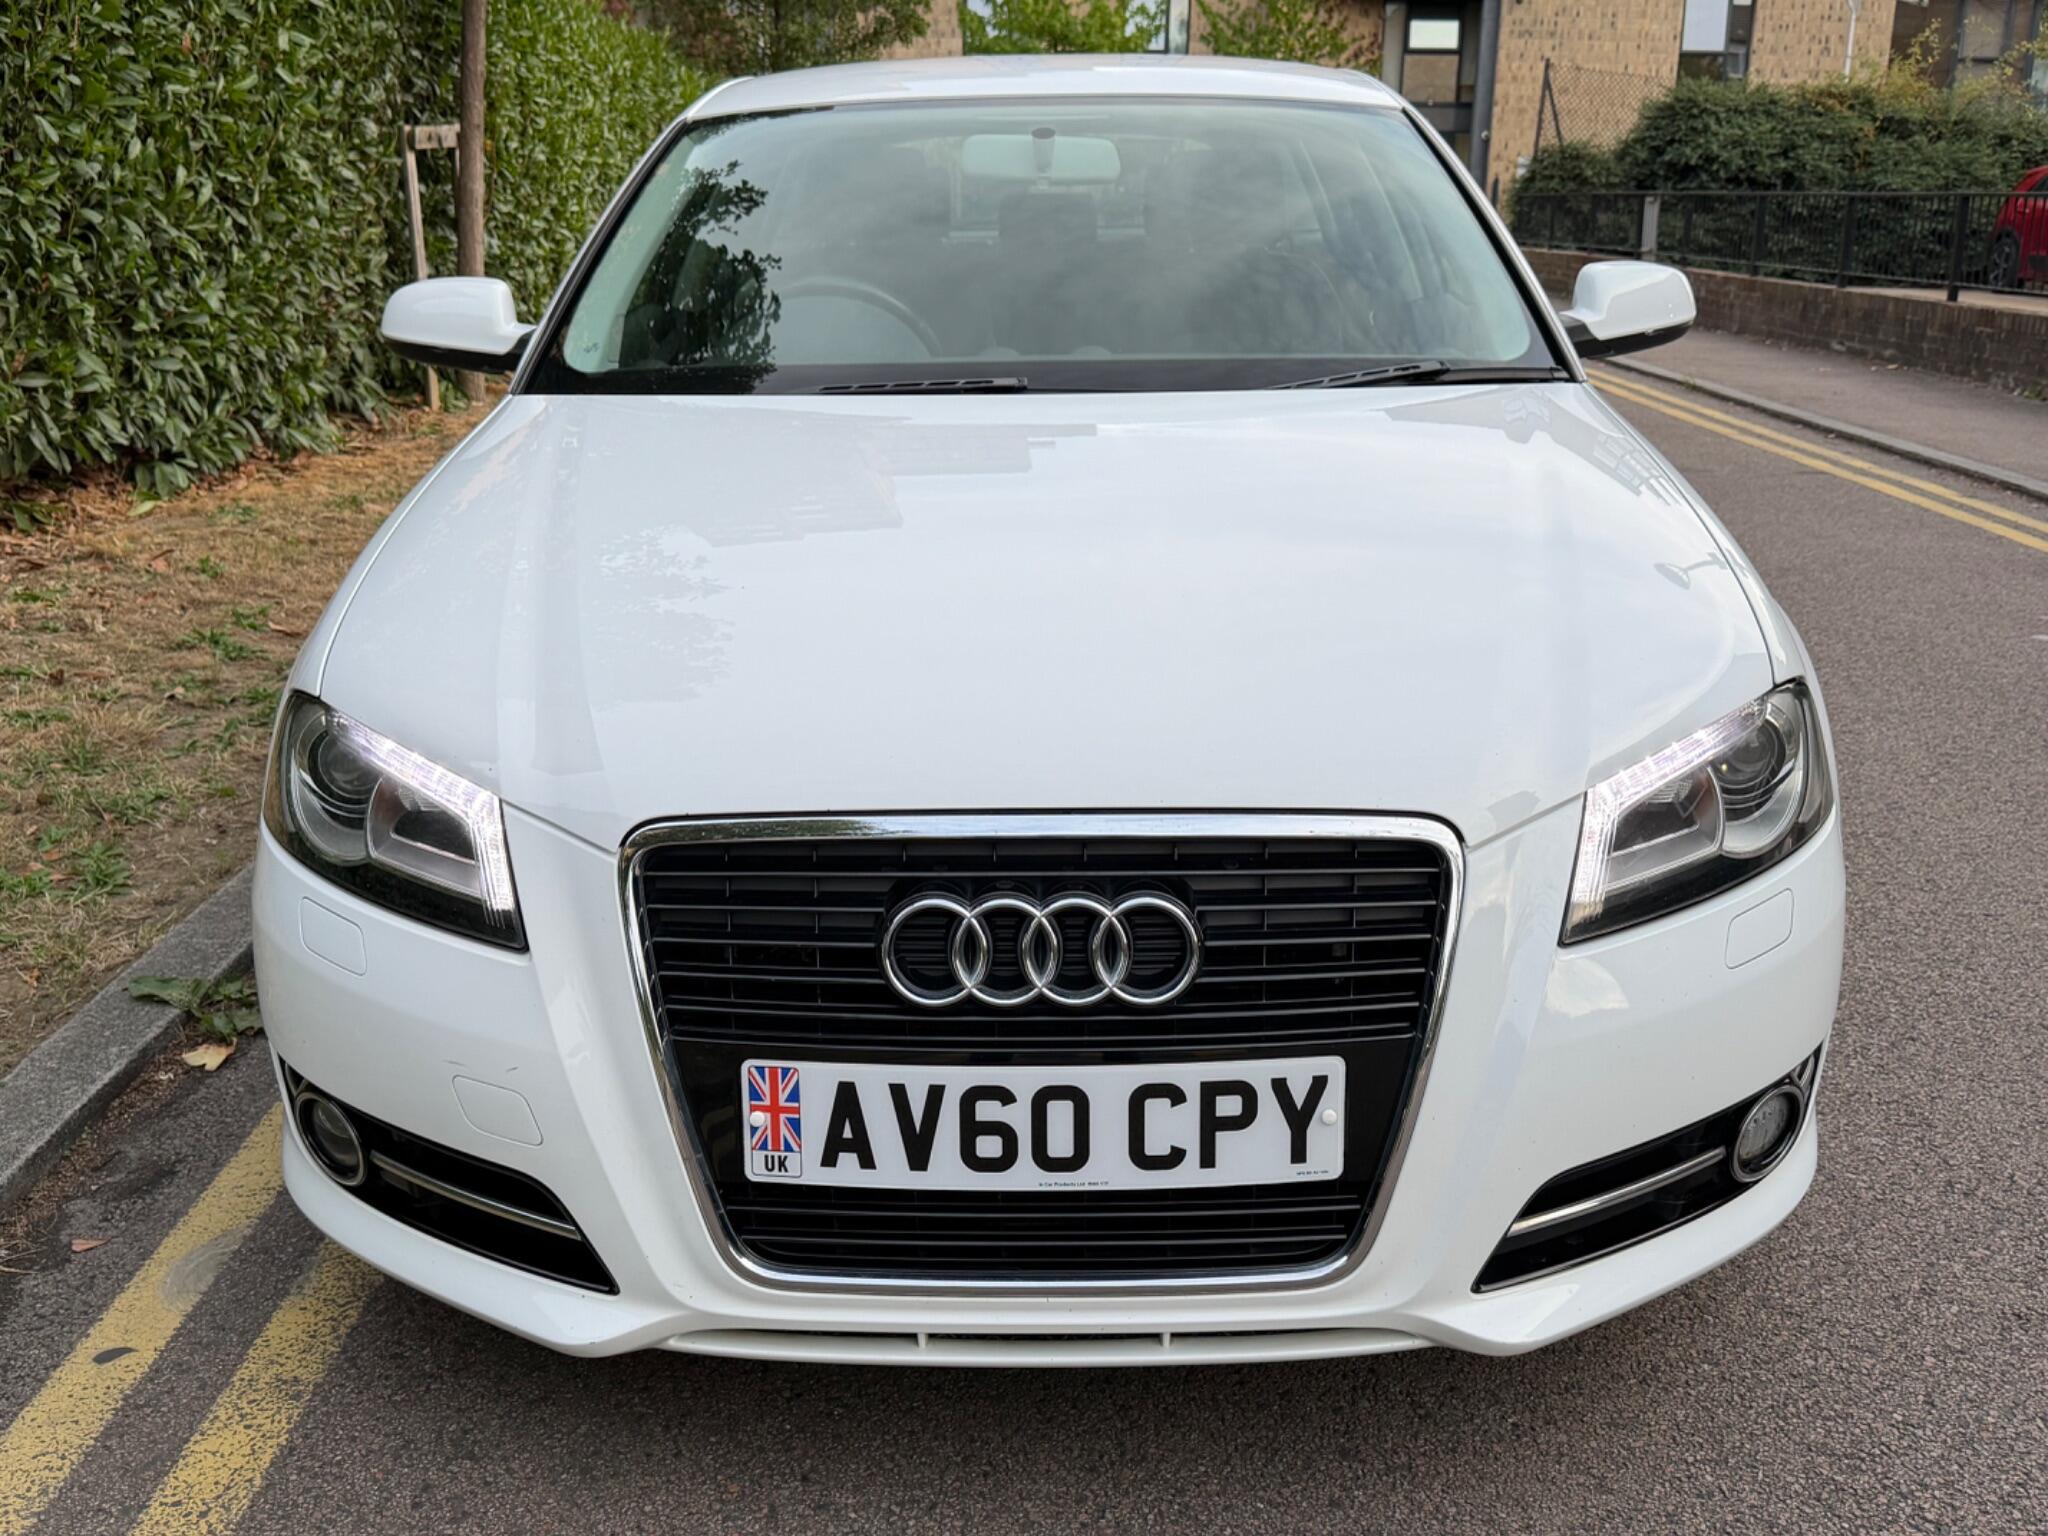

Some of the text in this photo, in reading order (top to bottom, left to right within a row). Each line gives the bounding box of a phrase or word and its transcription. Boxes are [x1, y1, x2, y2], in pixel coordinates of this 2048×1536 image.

[820, 1074, 1329, 1174] AV60 CPY
[764, 1154, 789, 1173] UK
